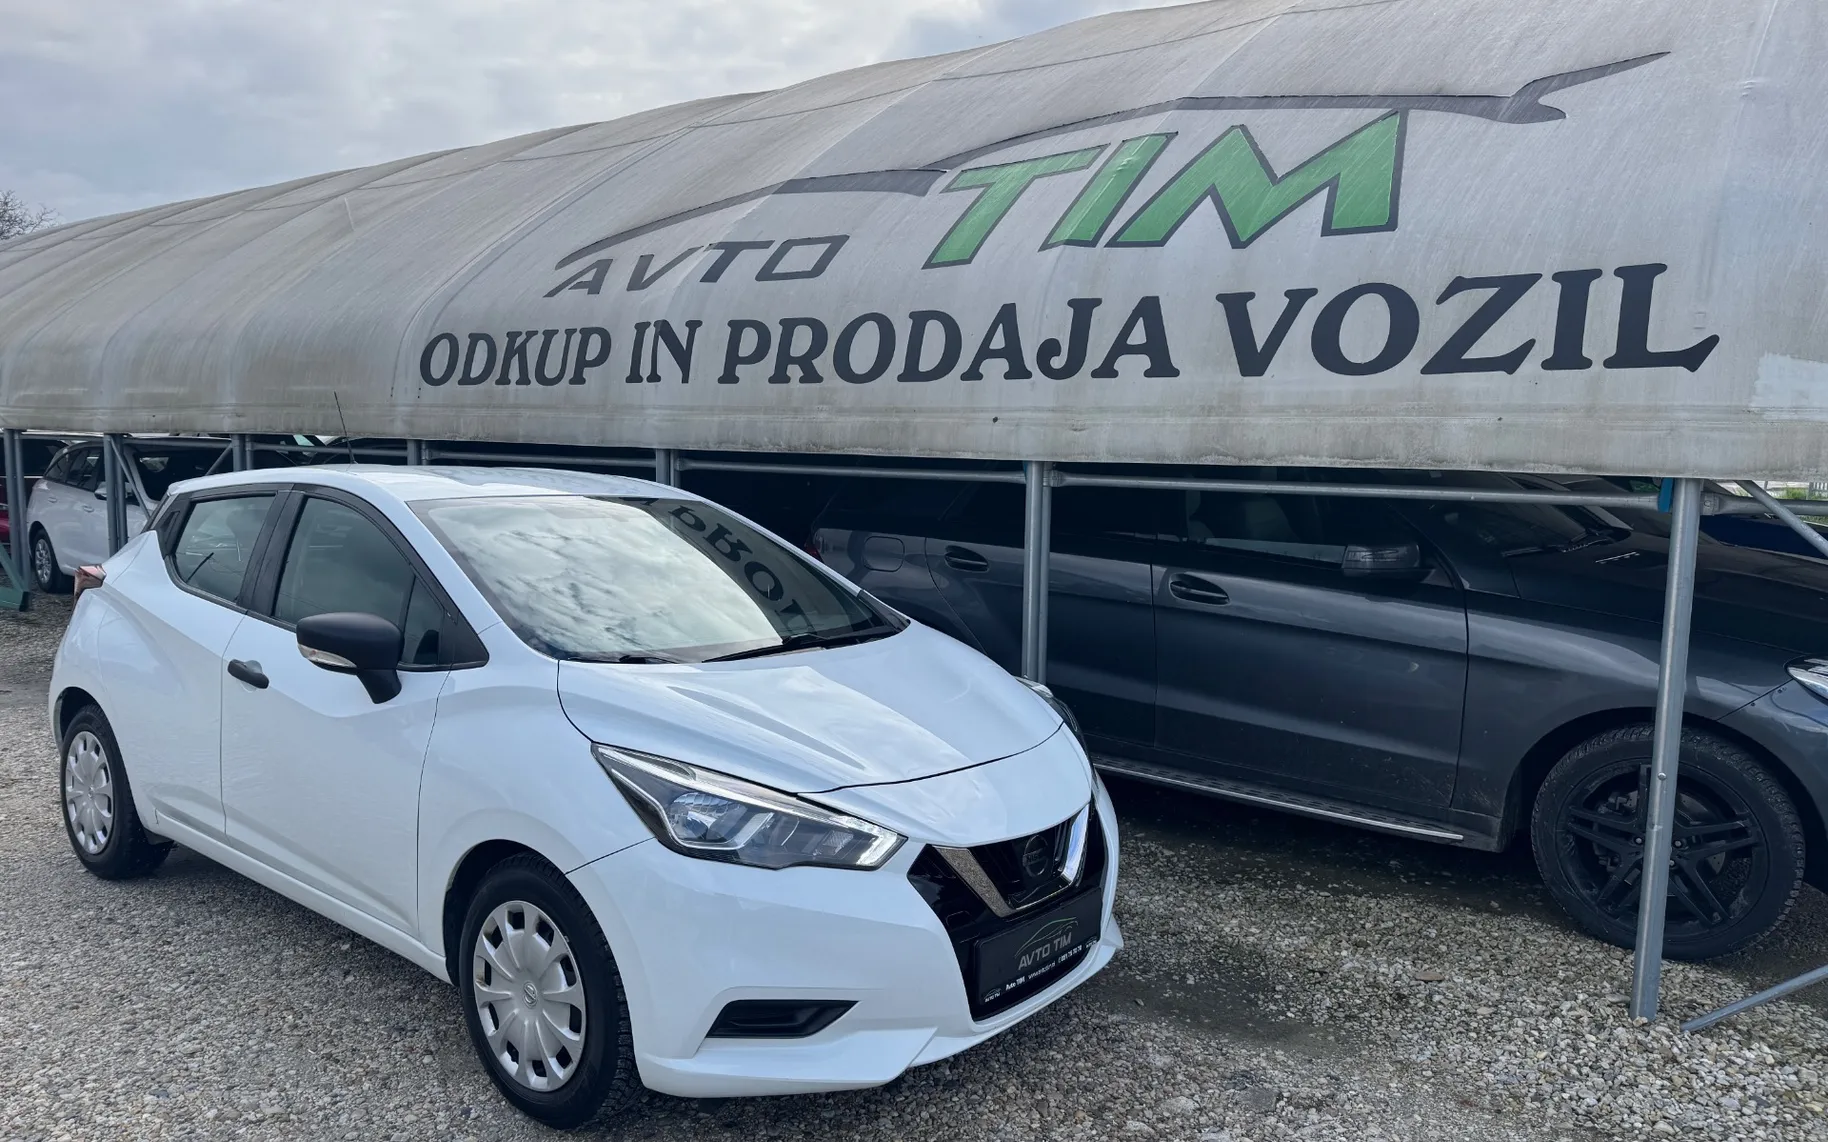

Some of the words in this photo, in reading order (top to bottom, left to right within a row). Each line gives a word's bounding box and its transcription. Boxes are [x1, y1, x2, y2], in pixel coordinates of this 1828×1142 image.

[544, 234, 850, 297] AVTO
[921, 109, 1408, 269] TIM
[420, 326, 612, 386] ODKUP
[625, 319, 703, 384] IN
[718, 295, 1181, 385] PRODAJA
[1216, 262, 1720, 377] VOZIL
[1018, 943, 1050, 970] AVTO
[1053, 931, 1072, 951] TIM
